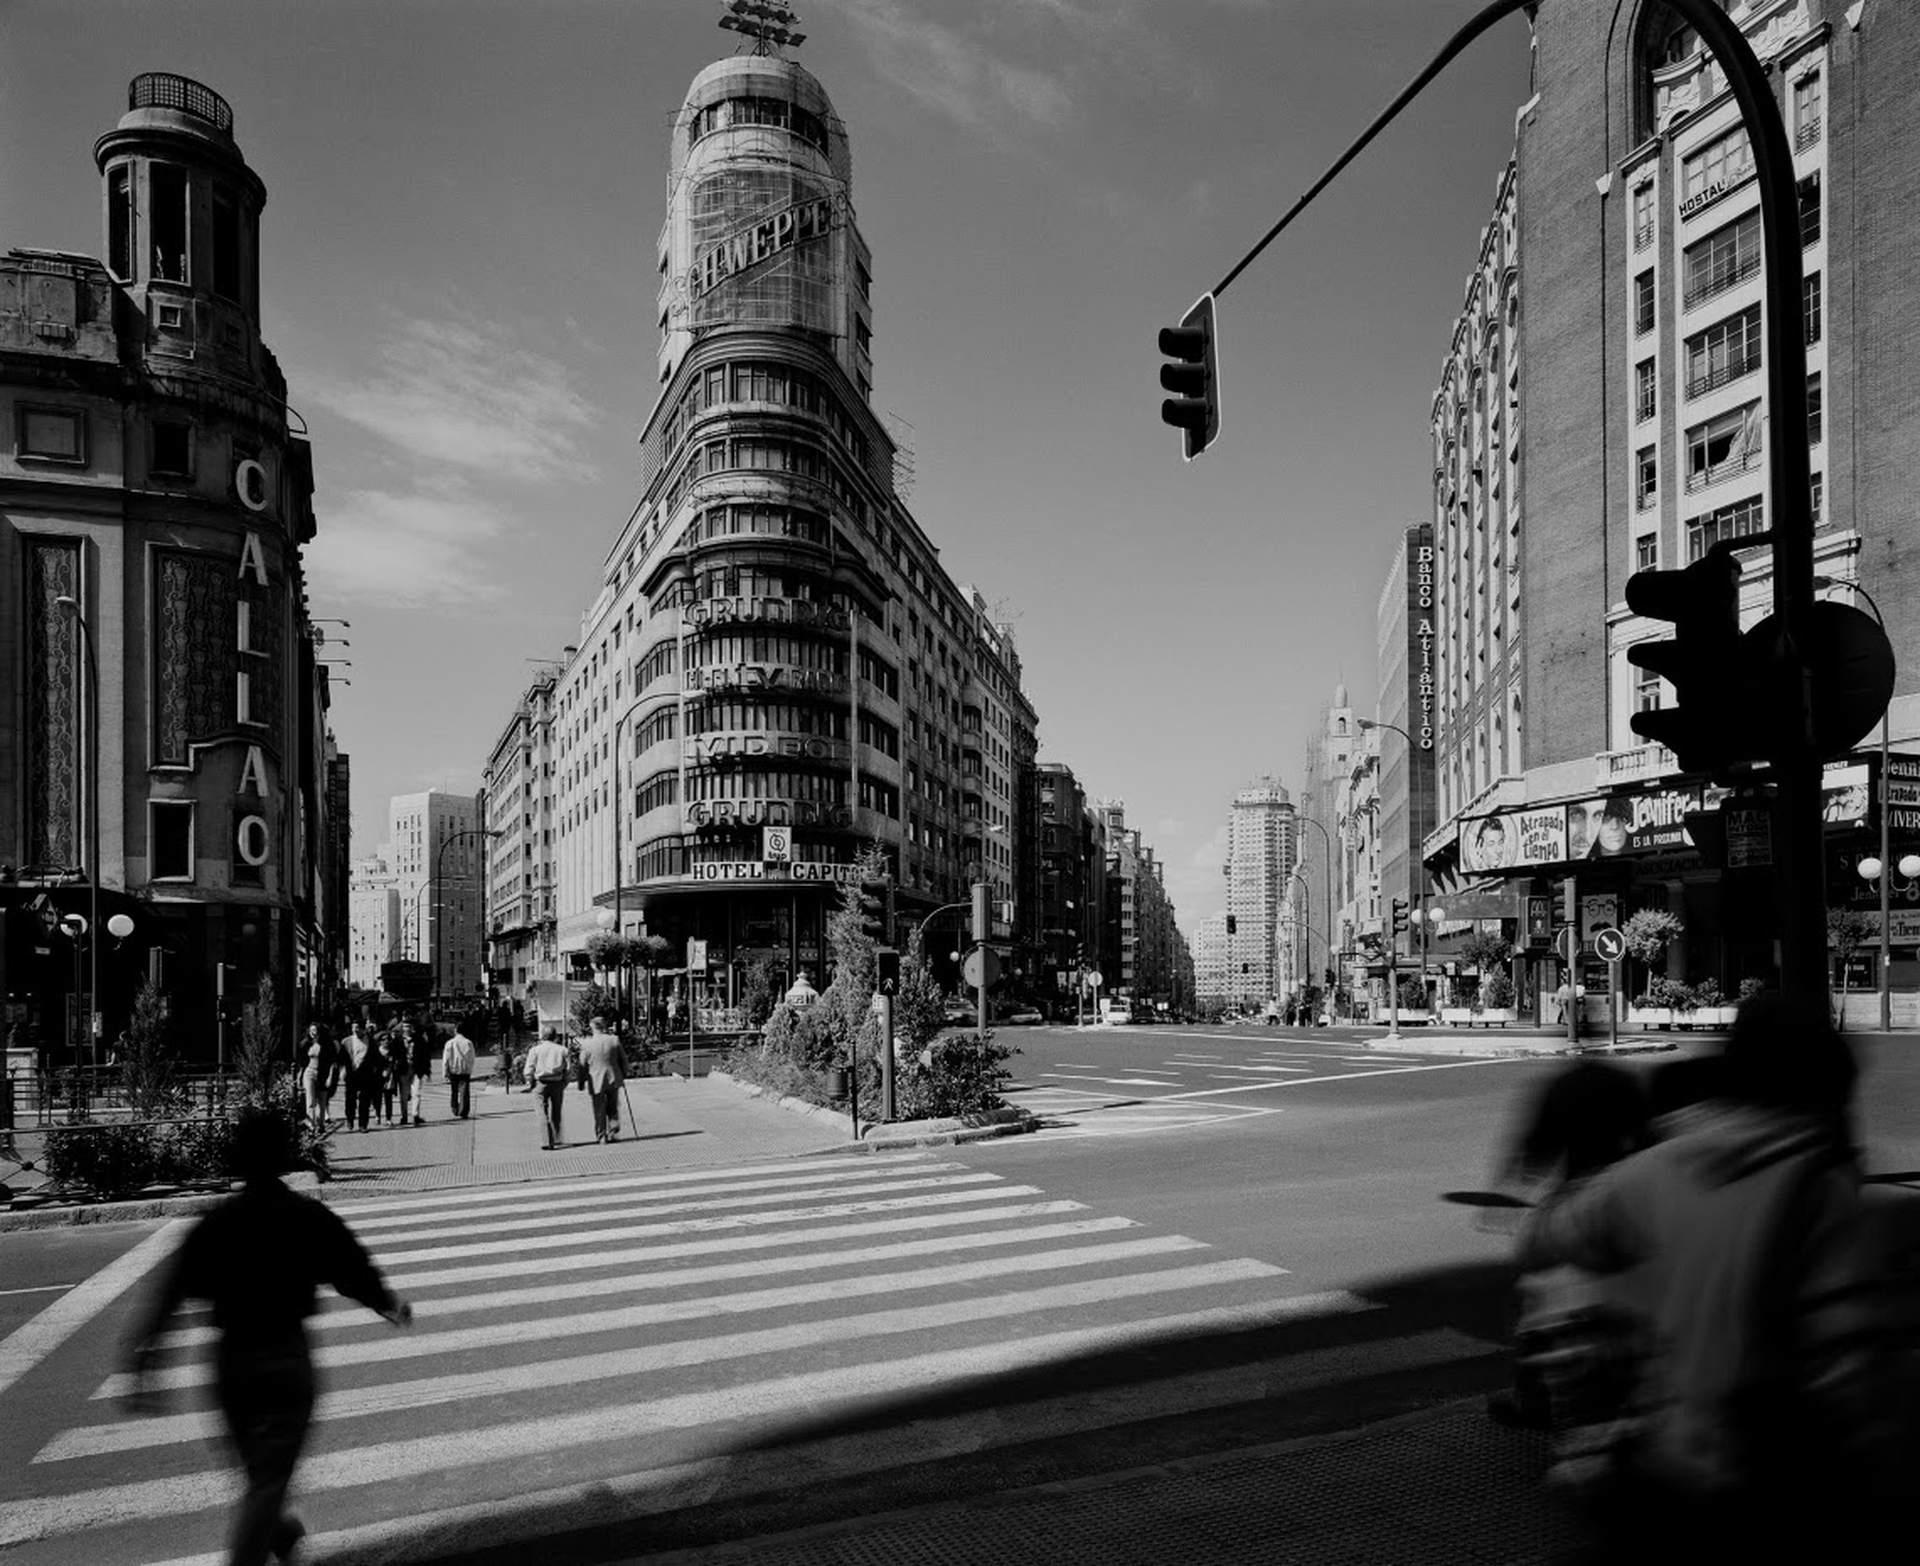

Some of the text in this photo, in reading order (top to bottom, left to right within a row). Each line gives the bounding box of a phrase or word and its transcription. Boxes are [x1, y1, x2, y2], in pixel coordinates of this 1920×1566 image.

[1679, 181, 1725, 216] HOSTAL
[1418, 546, 1434, 609] Banco
[685, 597, 851, 631] GRUNDIG
[235, 459, 270, 866] CALLAO
[687, 800, 852, 829] GRUNDIG
[1520, 812, 1563, 836] Atrapado
[1523, 841, 1559, 861] tiempo
[693, 862, 762, 880] HOTEL
